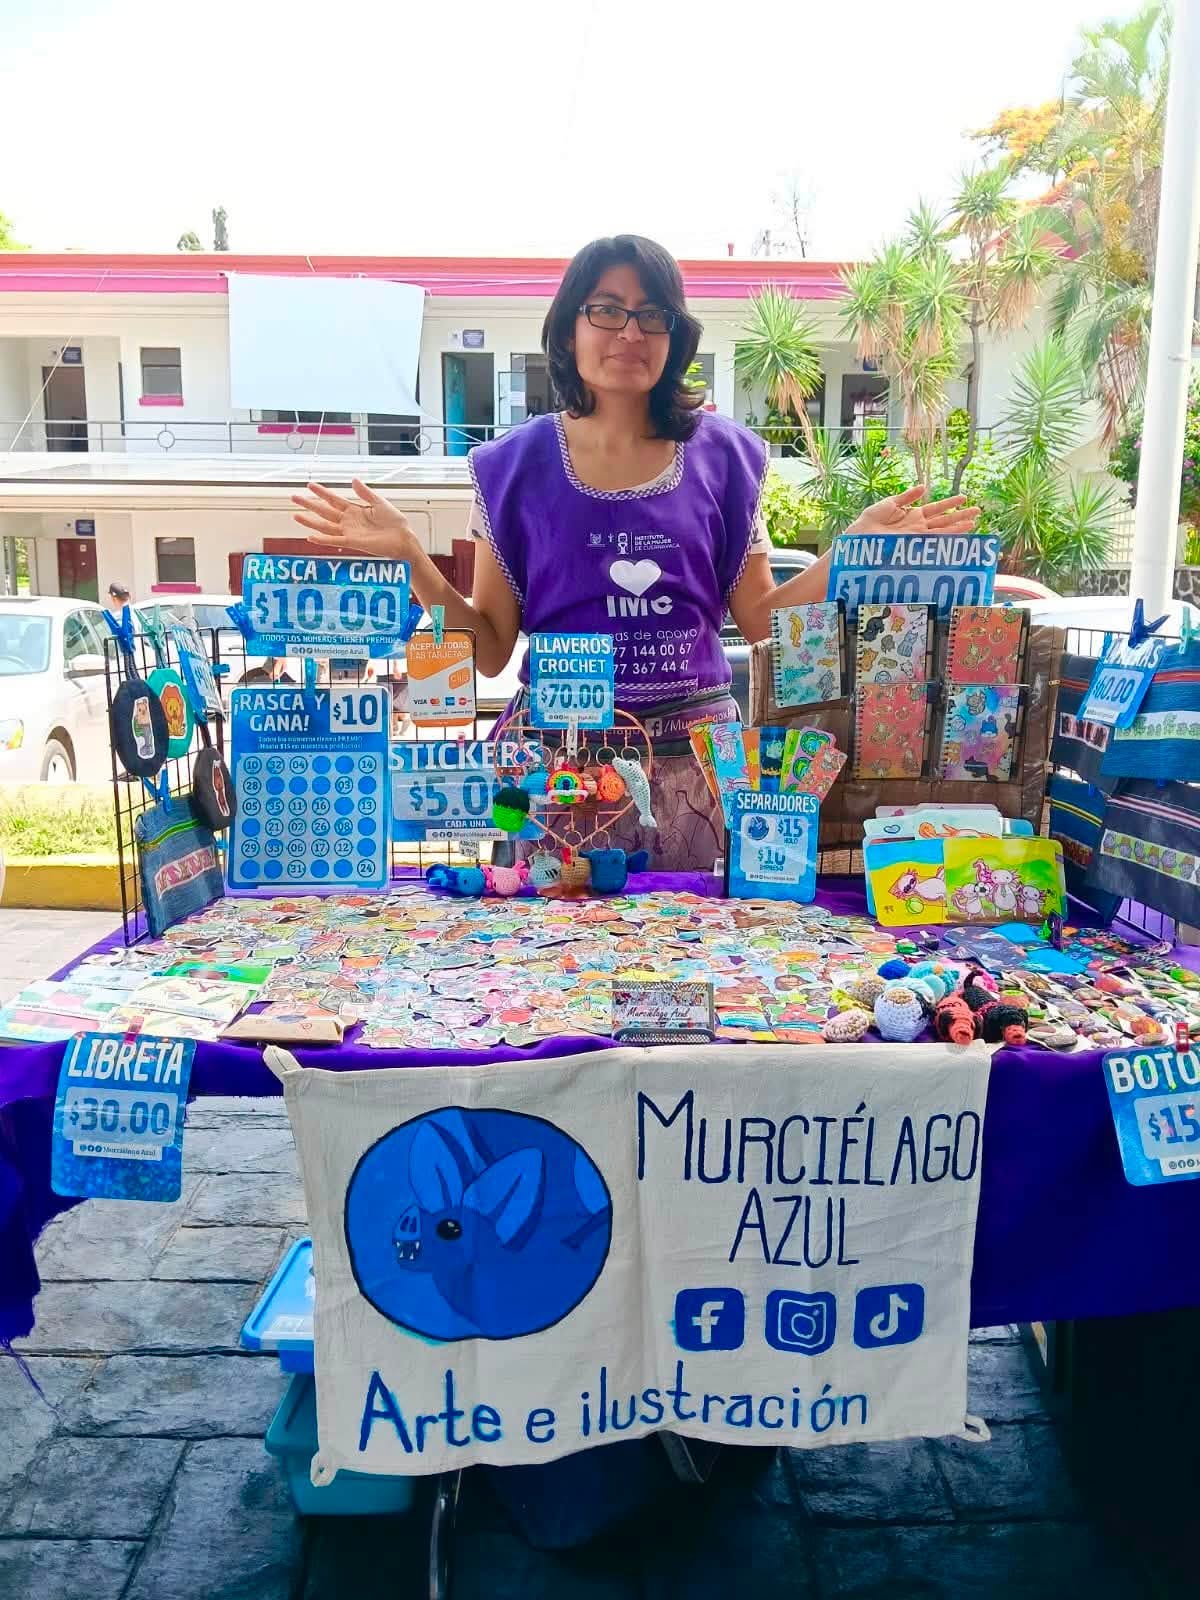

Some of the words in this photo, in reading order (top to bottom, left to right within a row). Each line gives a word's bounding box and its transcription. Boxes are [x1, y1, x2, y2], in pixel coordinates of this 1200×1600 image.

[833, 537, 886, 566] MINI
[890, 537, 997, 567] AGENDAS
[247, 558, 317, 581] RASCA
[328, 561, 342, 581] Y
[350, 562, 407, 584] GANA
[607, 595, 673, 617] IMC
[840, 574, 981, 616] $10000
[256, 588, 396, 631] $10.00
[535, 637, 611, 655] LLAVEROS
[633, 630, 652, 640] de
[656, 629, 698, 641] apoyo
[632, 645, 656, 657] 144
[660, 644, 675, 656] 00
[679, 643, 692, 655] 67
[539, 659, 606, 673] CROCHET
[632, 662, 656, 674] 367
[661, 661, 676, 673] 44
[233, 693, 305, 716] ¡RASCA
[314, 693, 326, 711] Y
[541, 684, 604, 709] $70.00
[332, 693, 378, 726] $10
[250, 714, 310, 732] GANA!
[388, 741, 541, 770] STICKERS
[737, 792, 816, 813] SEPARADORES
[445, 820, 468, 828] CADA
[470, 820, 487, 828] UNA
[778, 818, 803, 838] $15
[758, 846, 786, 866] $10
[68, 1038, 184, 1085] LIBRETA
[70, 1098, 170, 1135] $30.00
[1149, 1104, 1200, 1144] $15
[638, 1090, 980, 1186] MURCIÉLAGO
[728, 1187, 859, 1268] AZUL
[359, 1369, 501, 1453] Arte
[526, 1408, 556, 1443] e
[580, 1360, 867, 1437] ilustración
